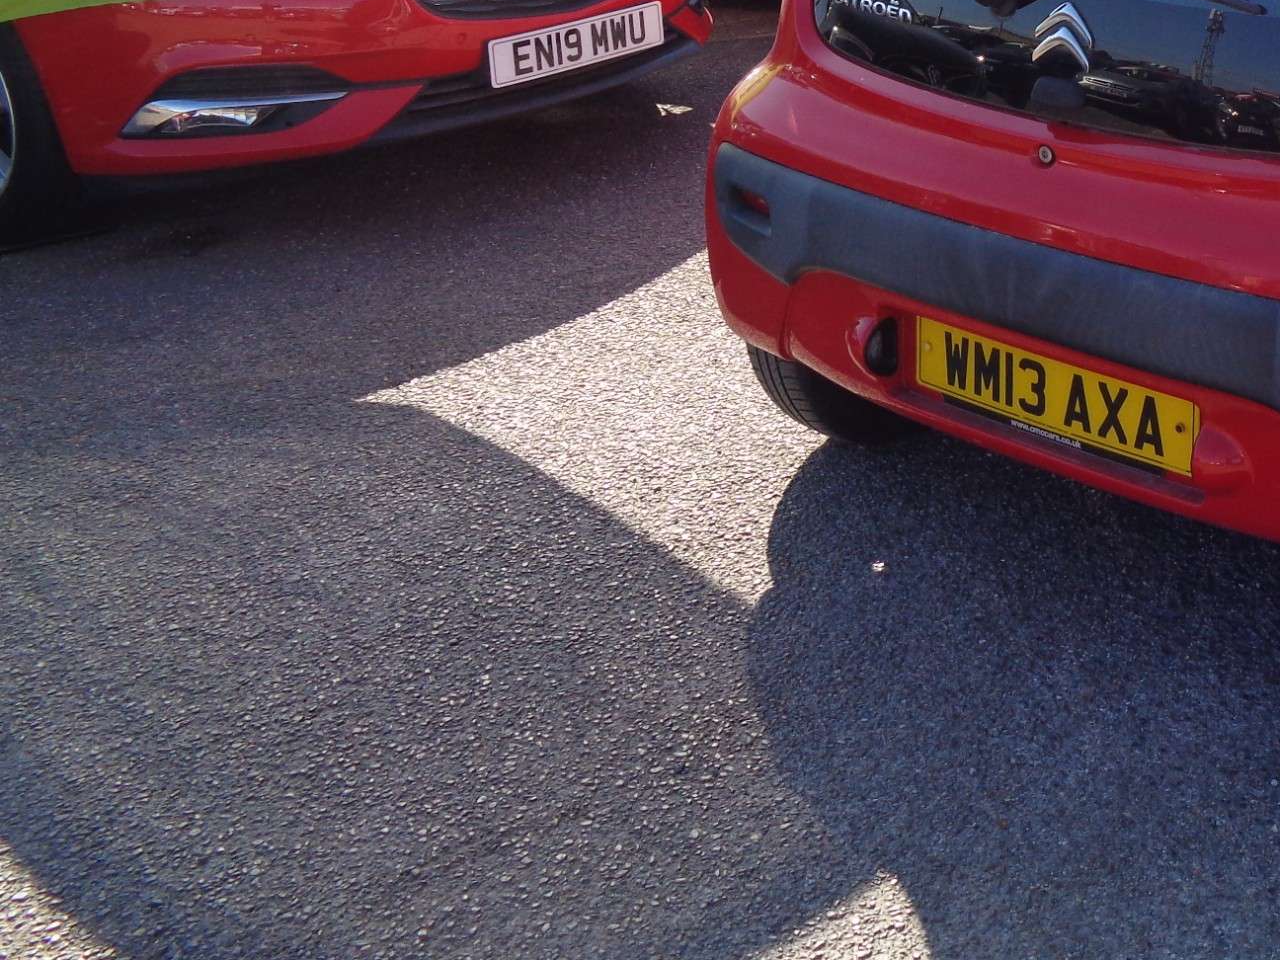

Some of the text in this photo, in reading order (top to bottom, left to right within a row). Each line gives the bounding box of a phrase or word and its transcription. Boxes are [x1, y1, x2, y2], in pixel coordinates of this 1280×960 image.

[512, 11, 646, 76] EN19 MWU
[944, 331, 1165, 457] WM13 AXA
